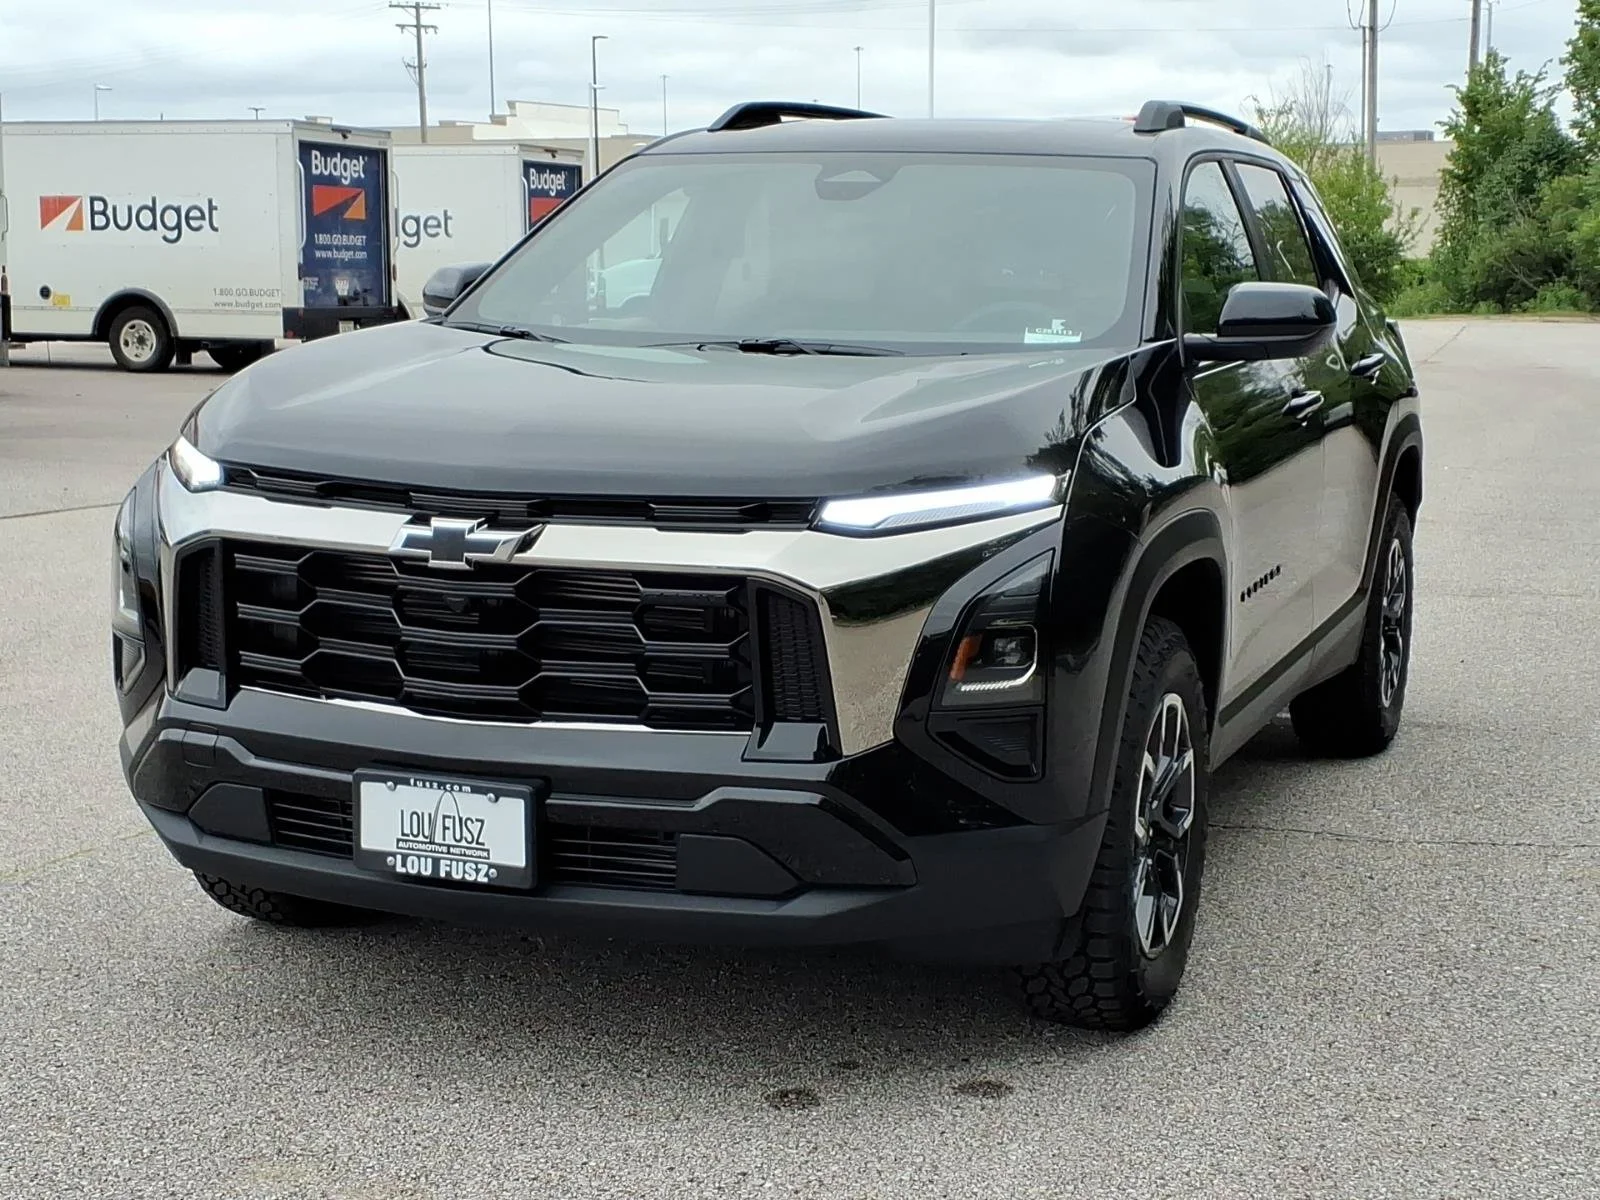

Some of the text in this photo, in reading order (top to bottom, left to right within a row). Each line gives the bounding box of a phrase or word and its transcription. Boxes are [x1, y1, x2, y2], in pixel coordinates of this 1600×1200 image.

[311, 150, 365, 185] Budget
[529, 168, 566, 195] Budget
[89, 196, 219, 244] Budget
[395, 208, 453, 249] get
[314, 248, 368, 261] www.budget.com
[214, 300, 281, 309] www.budget.com
[410, 777, 472, 793] fusz.com
[400, 809, 486, 847] LOU FUSZ
[398, 841, 489, 858] AUTOMOTIVE NETWORK
[395, 854, 489, 883] LOU FUSZ
